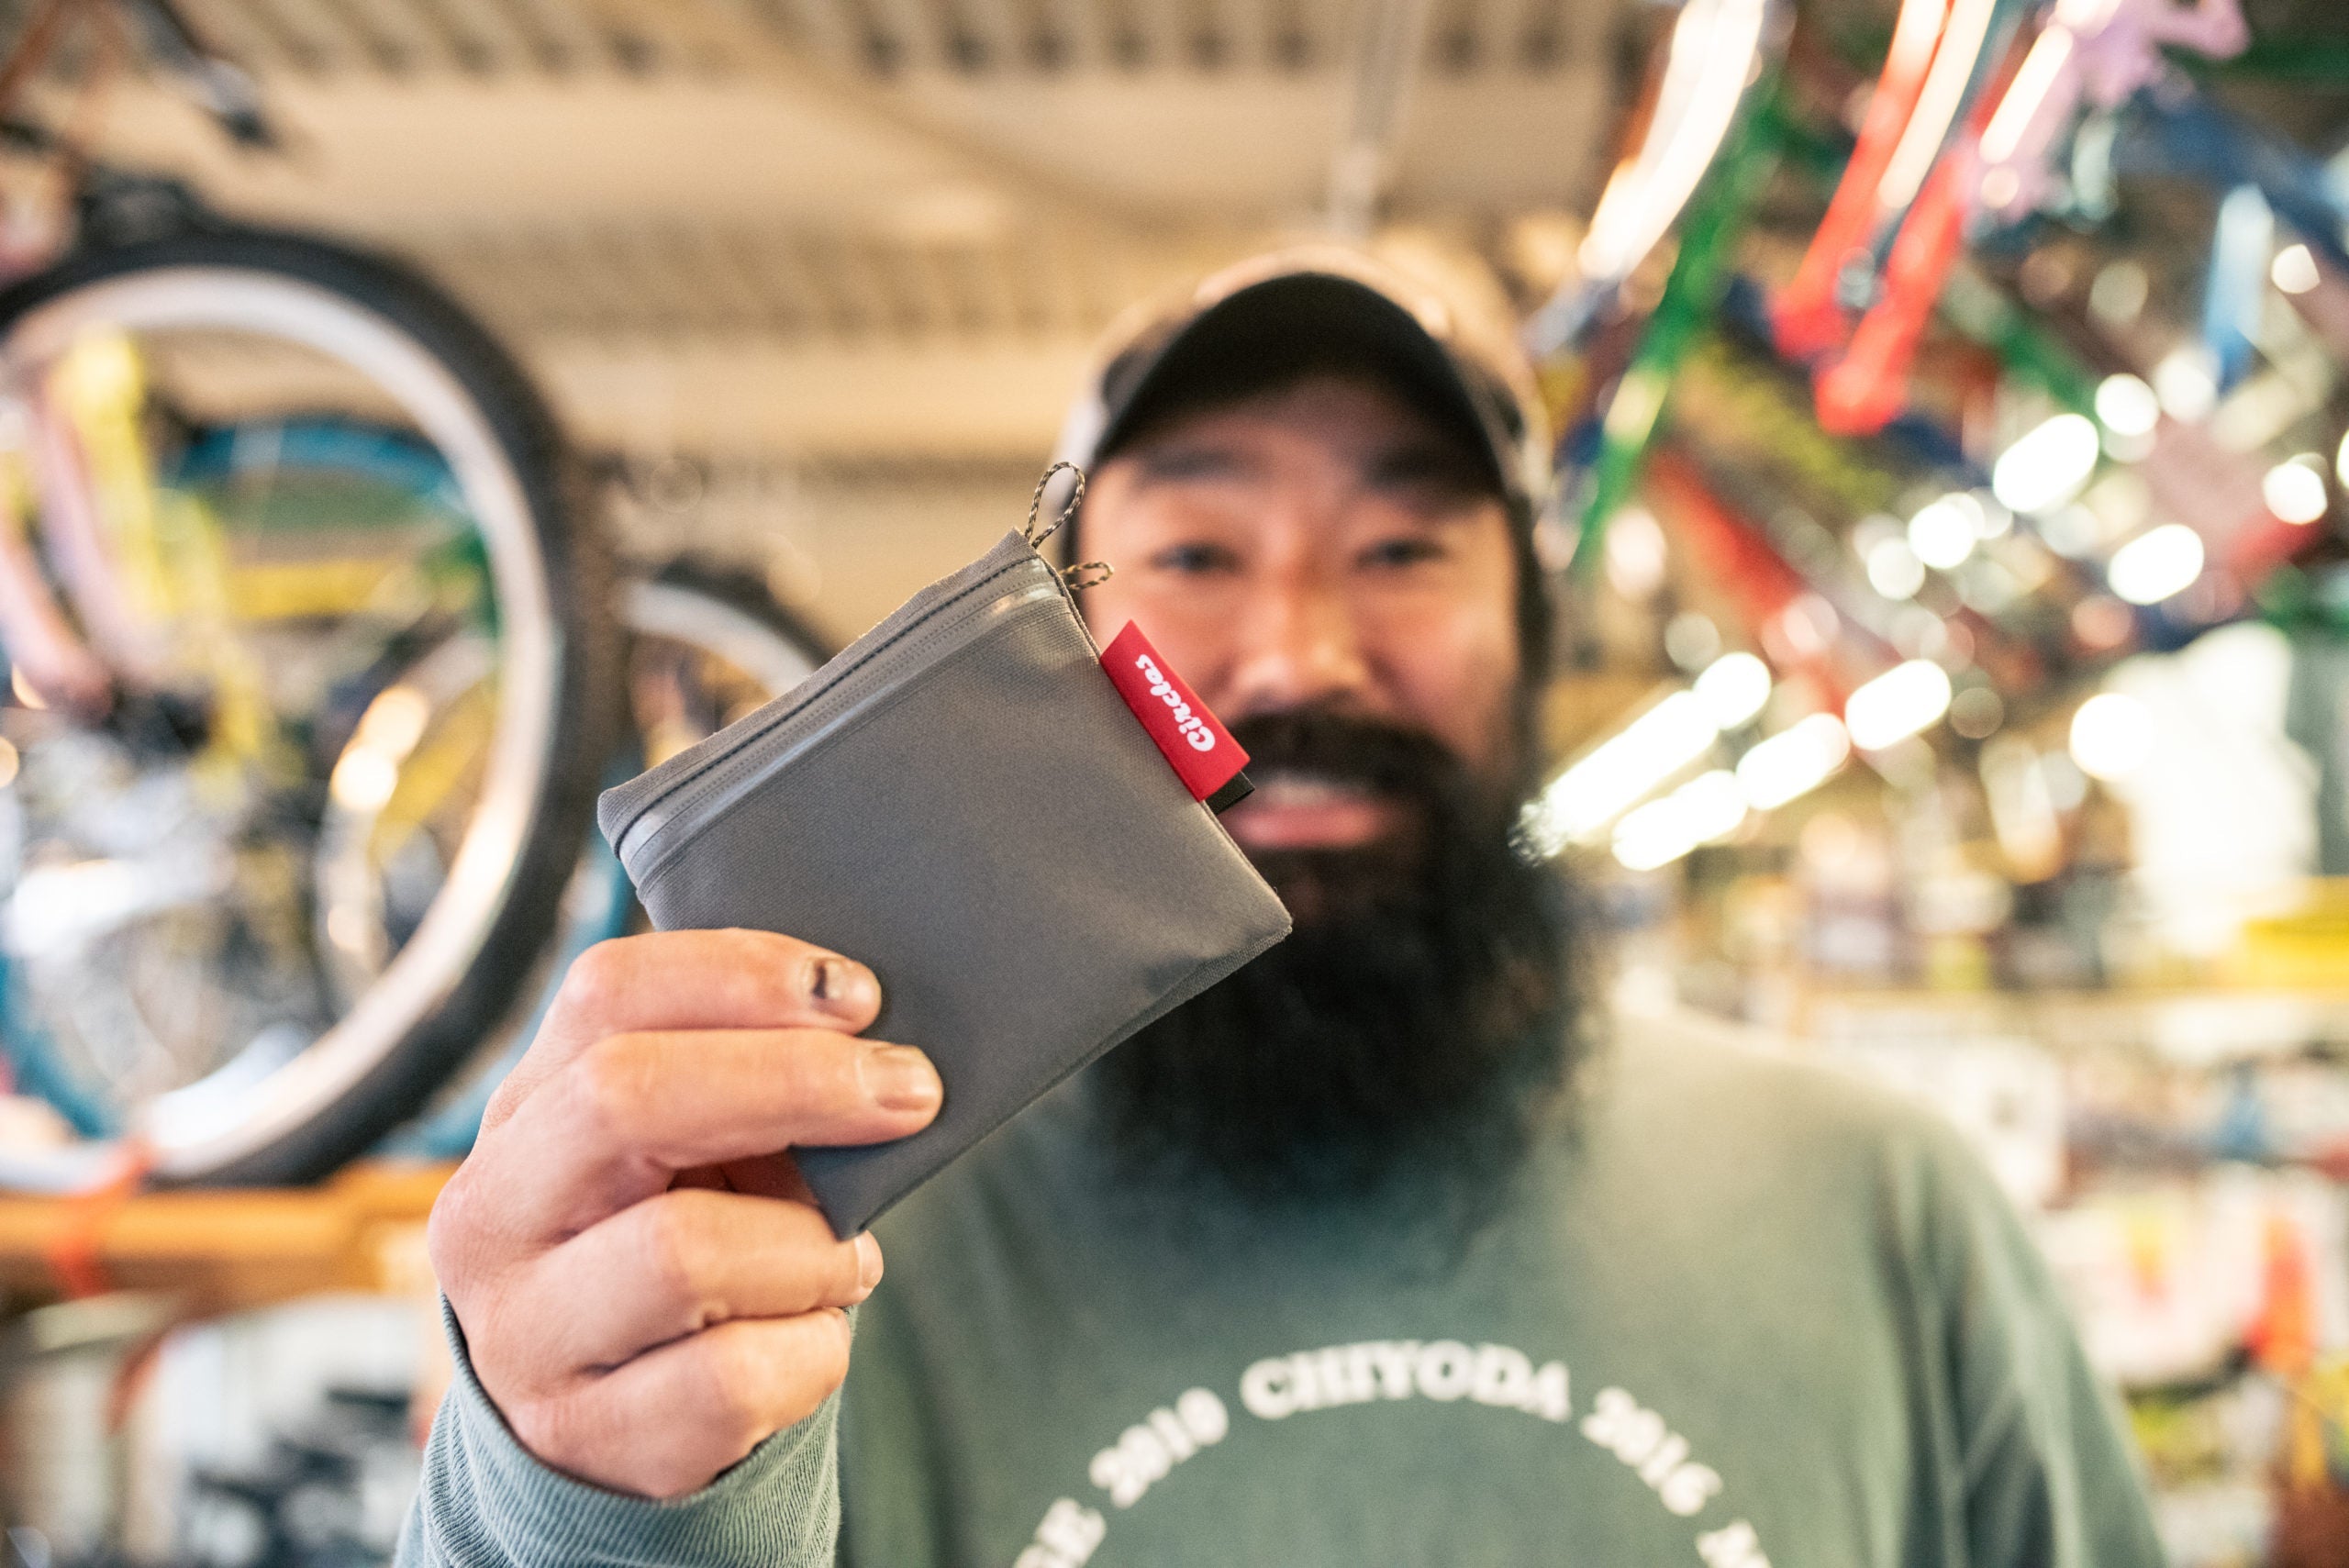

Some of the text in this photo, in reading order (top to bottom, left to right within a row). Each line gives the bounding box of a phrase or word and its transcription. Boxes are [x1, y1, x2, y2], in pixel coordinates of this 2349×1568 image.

[1135, 654, 1216, 752] Circles
[1090, 1387, 1229, 1507] 2010
[1240, 1339, 1572, 1421] CHIYODA
[1581, 1385, 1722, 1517] 2016
